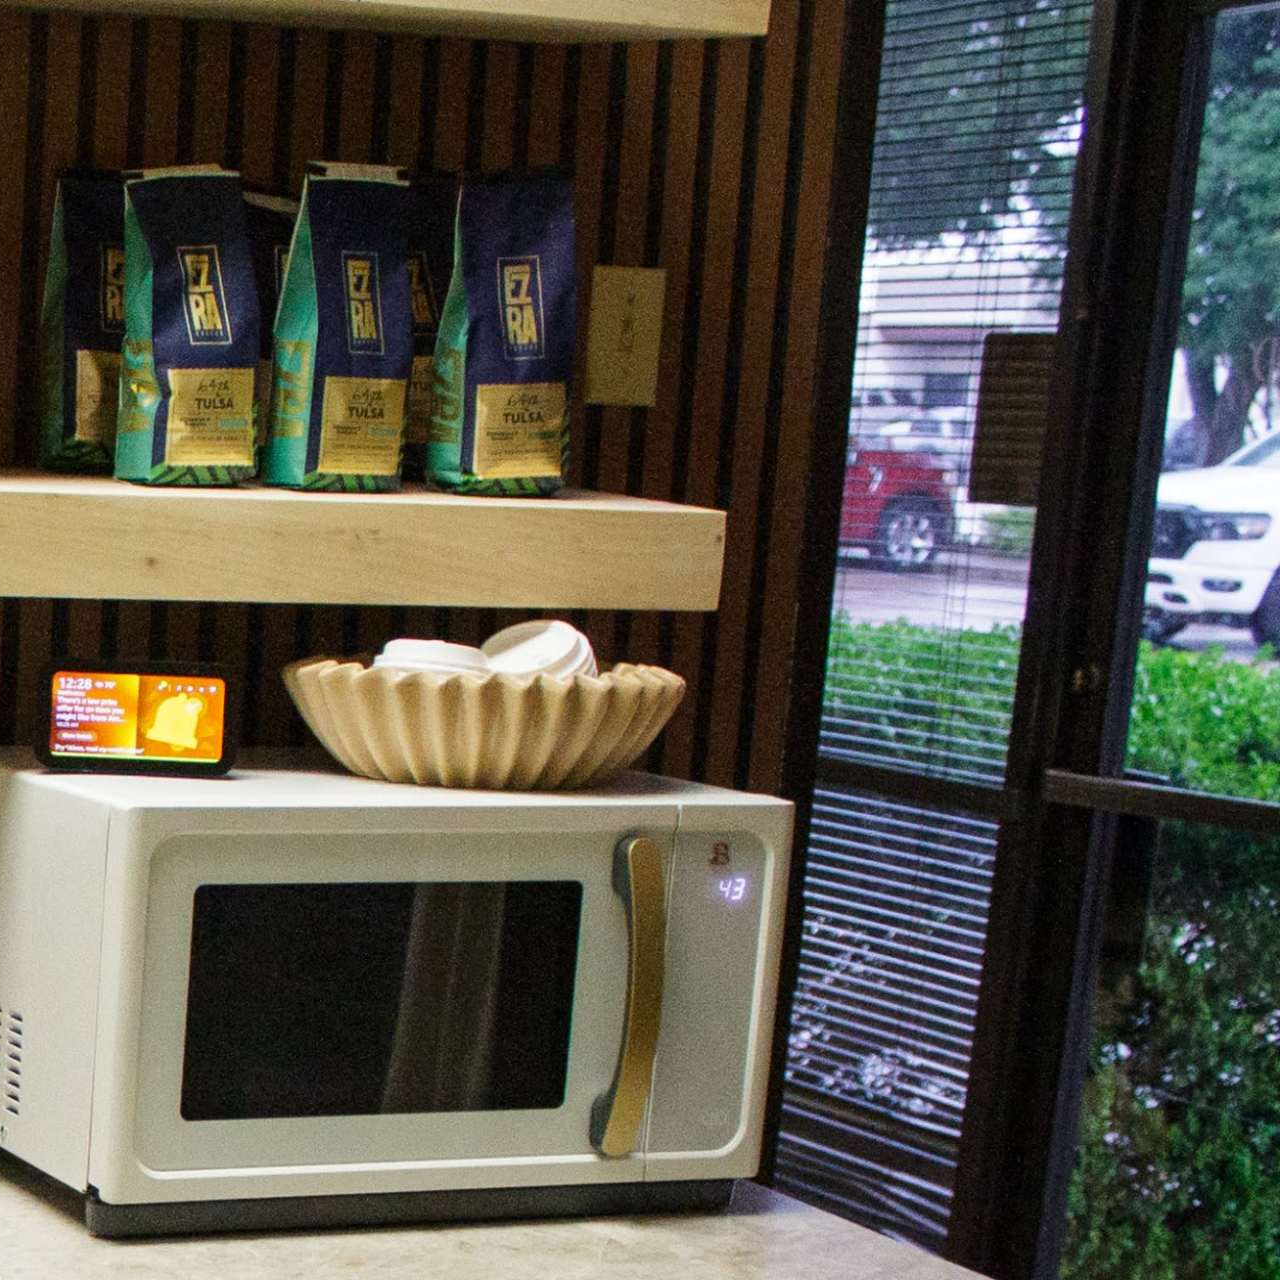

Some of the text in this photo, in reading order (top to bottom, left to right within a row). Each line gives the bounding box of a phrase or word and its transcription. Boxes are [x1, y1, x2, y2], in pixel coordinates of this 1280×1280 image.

[504, 265, 532, 304] EZ
[189, 292, 223, 331] RA
[506, 304, 538, 345] RA
[194, 397, 235, 411] TULSA
[347, 405, 385, 419] TULSA
[503, 411, 545, 424] TULSA
[59, 677, 93, 691] 12:28
